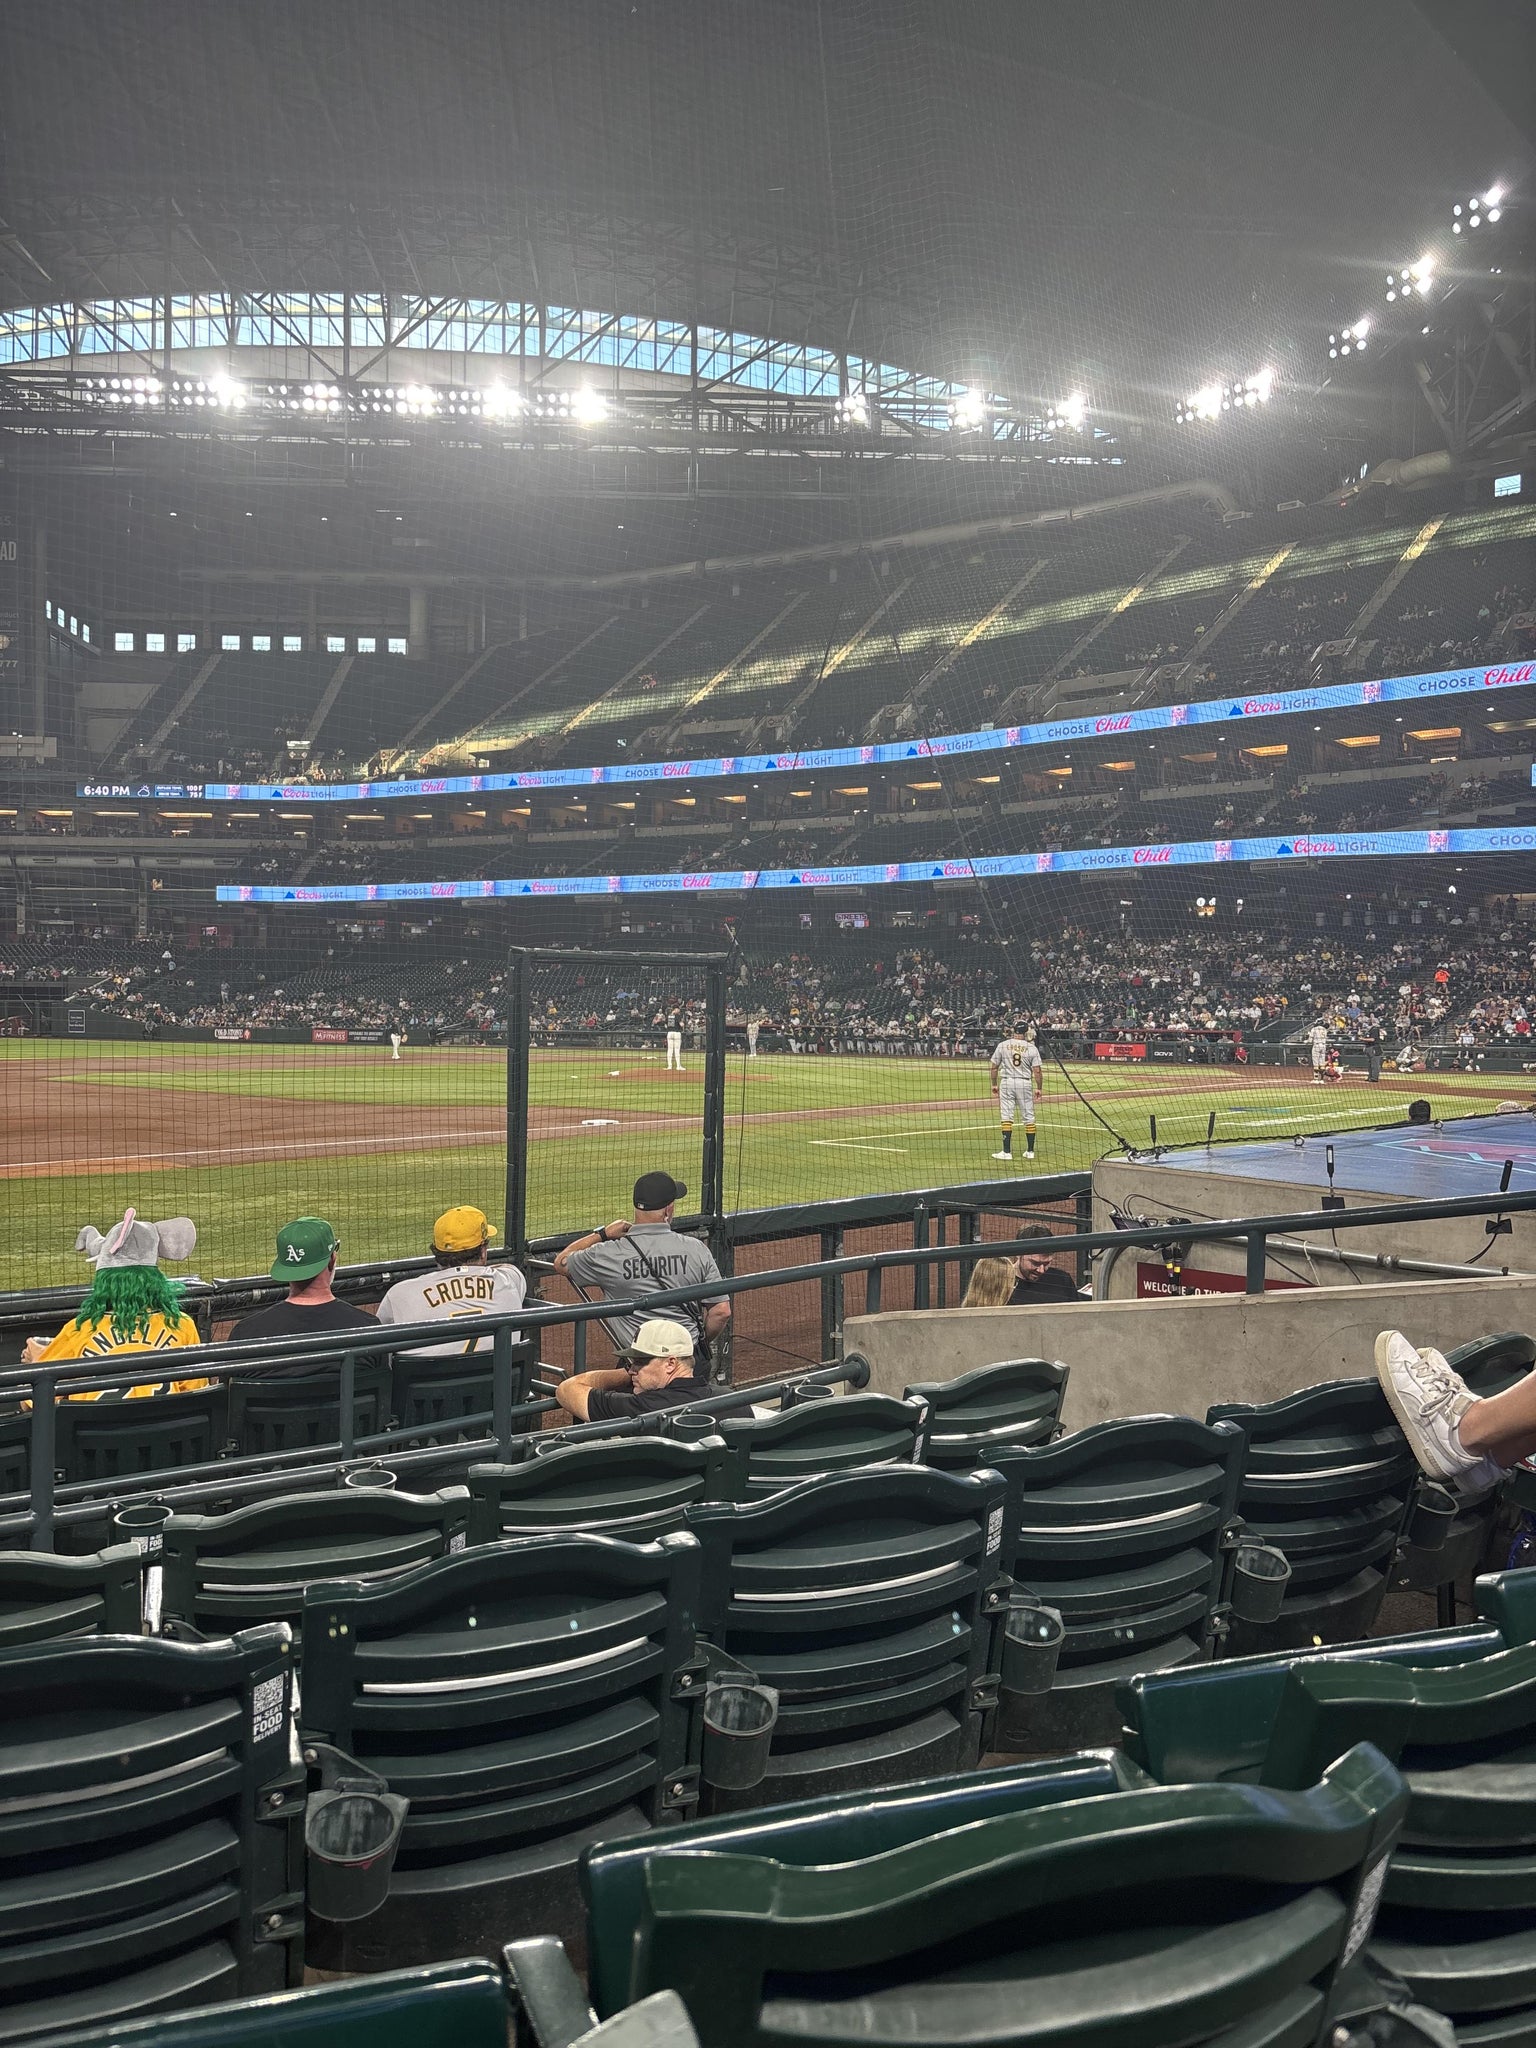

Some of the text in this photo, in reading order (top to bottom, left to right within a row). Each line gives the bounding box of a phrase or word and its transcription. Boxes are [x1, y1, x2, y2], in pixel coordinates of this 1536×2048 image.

[1419, 664, 1536, 692] CHOOSE Chill
[1244, 697, 1318, 714] Coors LIGHT
[1048, 715, 1132, 737] CHOOSE Chill
[625, 762, 691, 777] CHOOSE Chill
[84, 785, 130, 796] 6:40 PM
[388, 780, 446, 793] CHOOSE Chill
[1293, 838, 1378, 854] Coors LIGHT
[1489, 834, 1536, 846] CHOO
[1082, 847, 1173, 865] CHOOSE Chill
[643, 874, 714, 888] CHOOSE Chill
[801, 872, 858, 884] Coors LIGHT
[1013, 1053, 1021, 1067] 8
[286, 1244, 305, 1262] A's
[623, 1255, 688, 1280] SECURITY
[423, 1277, 495, 1308] CROSBY
[1143, 1281, 1187, 1296] WELCE
[149, 1538, 163, 1547] FOO
[254, 1703, 283, 1724] IN-SEAT
[254, 1712, 283, 1736] FOOD
[253, 1723, 282, 1743] DELIVERY
